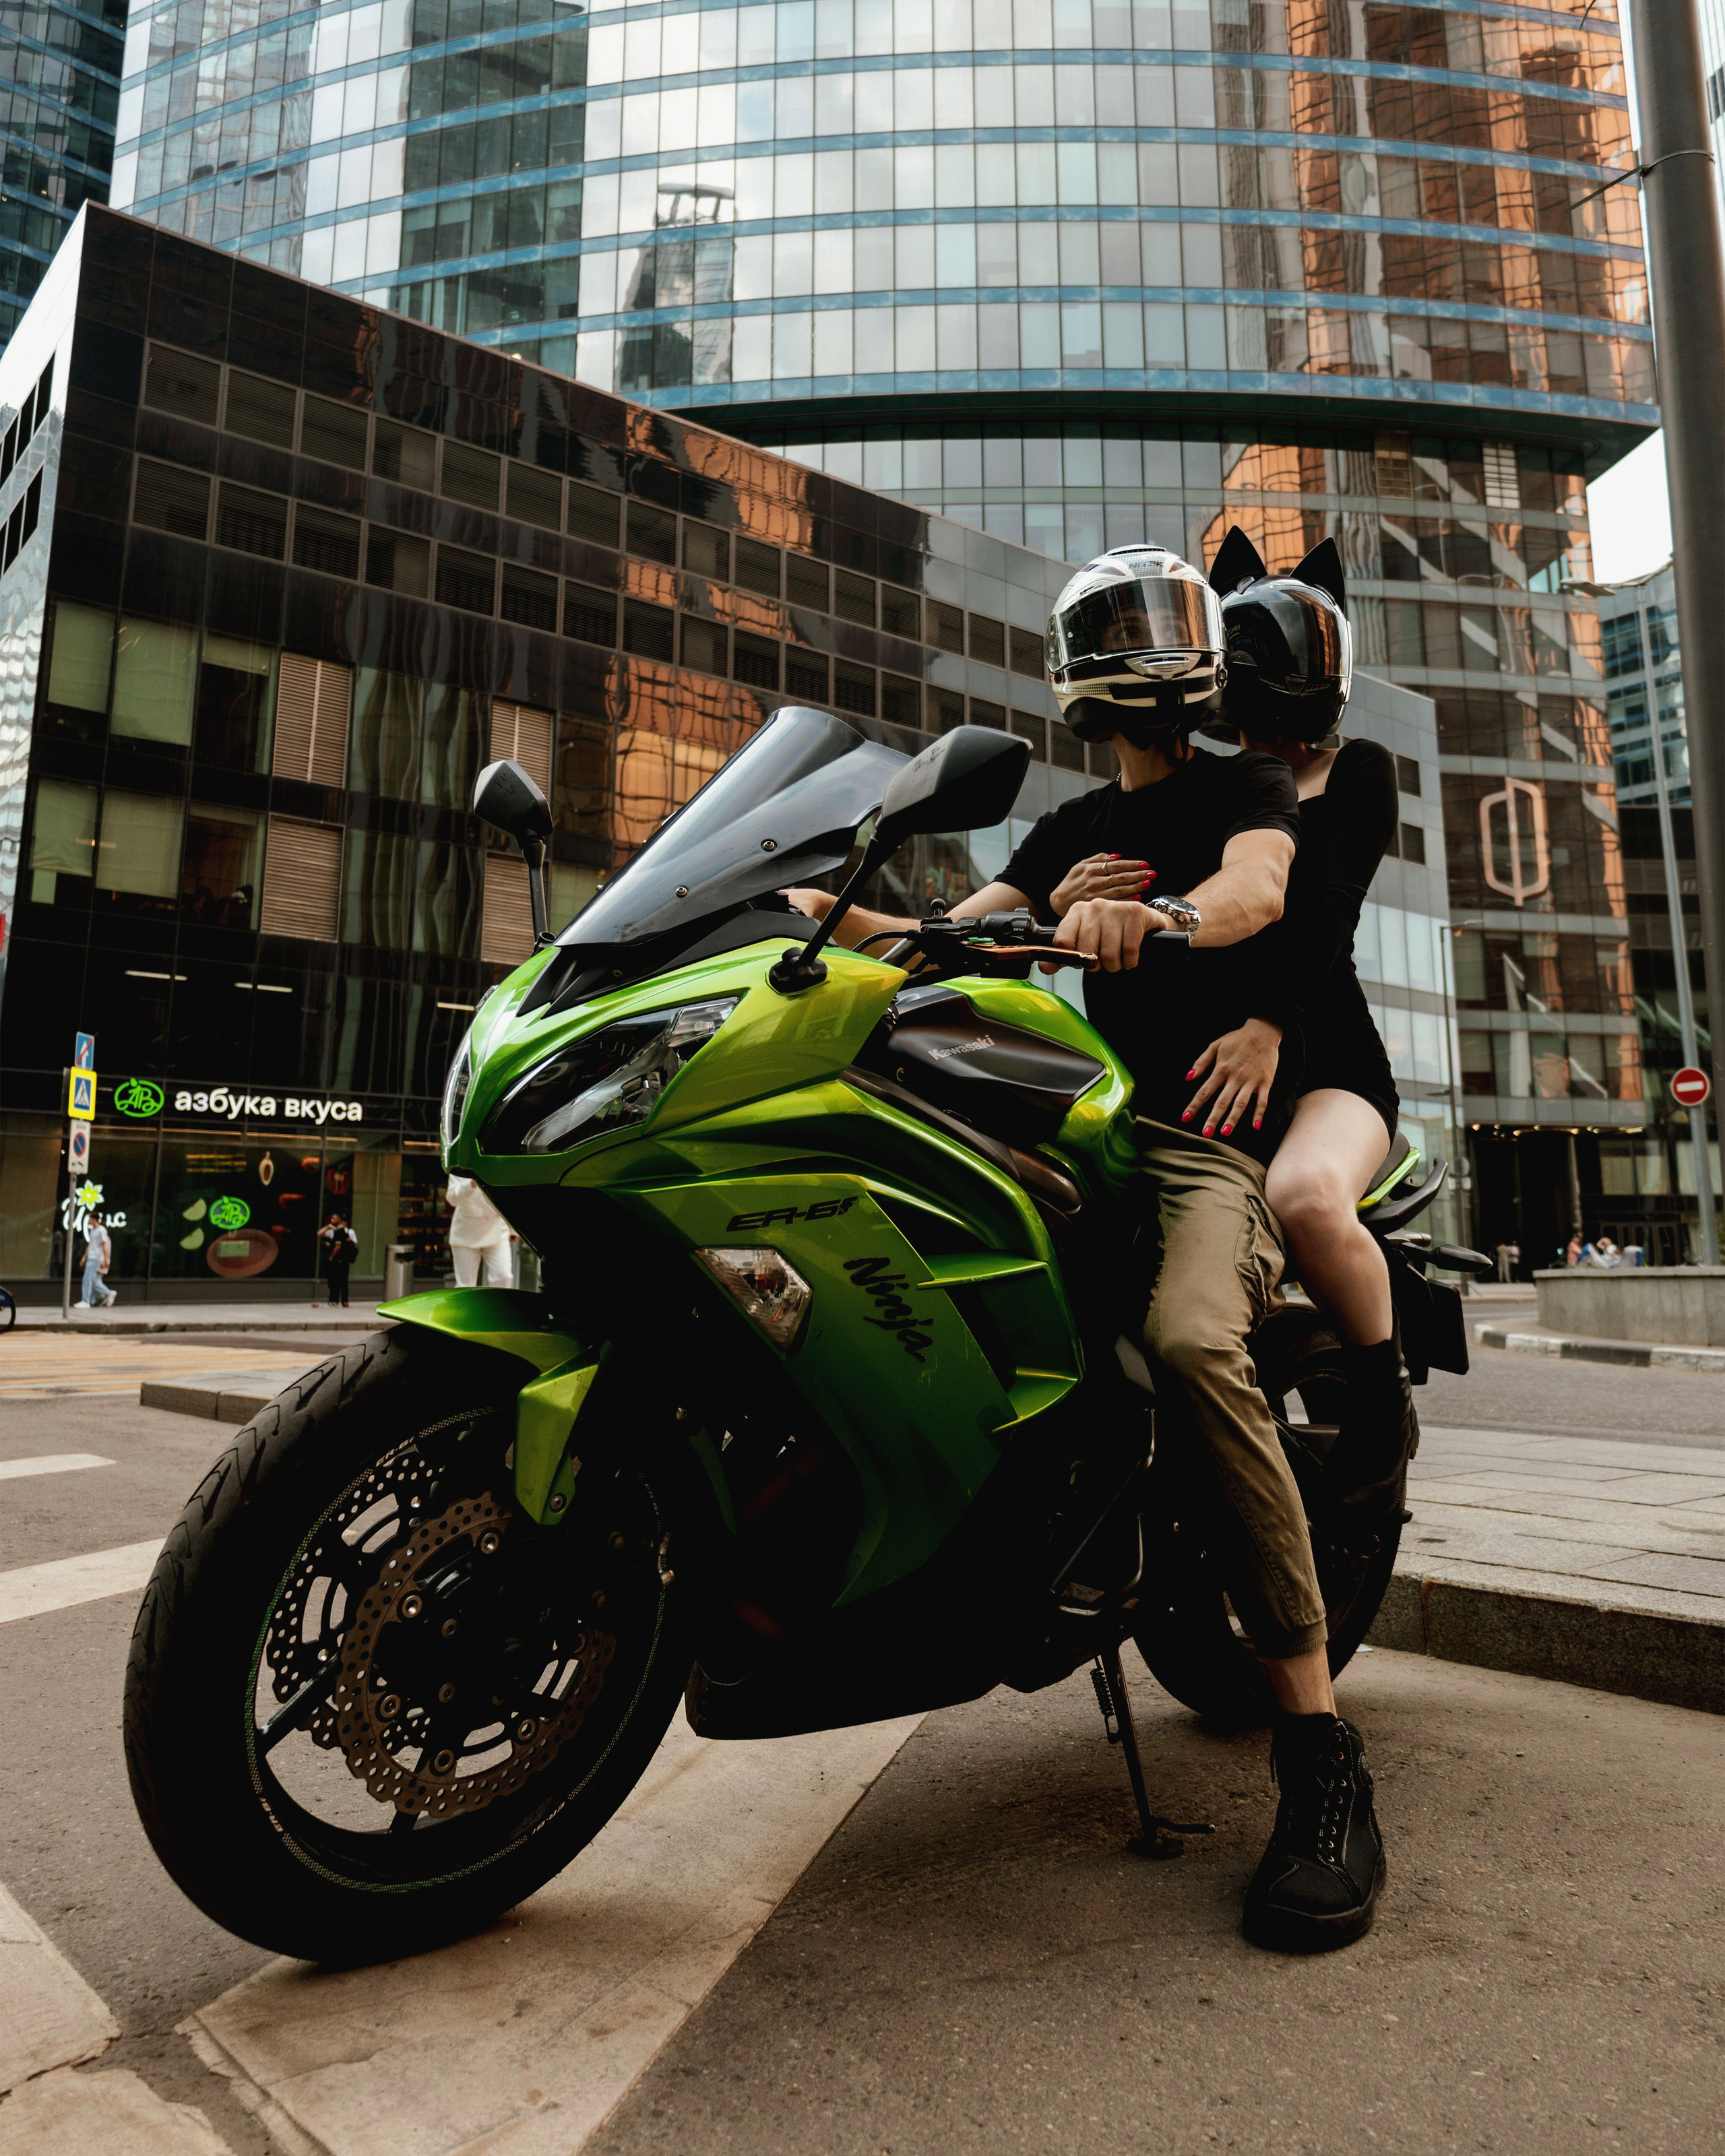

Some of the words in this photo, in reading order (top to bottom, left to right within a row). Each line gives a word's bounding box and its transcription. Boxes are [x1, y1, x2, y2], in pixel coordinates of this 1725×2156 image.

[927, 1034, 995, 1061] Kawasaki
[175, 1087, 277, 1120] азбука
[284, 1097, 363, 1125] вкуса
[843, 1257, 933, 1362] Ninja
